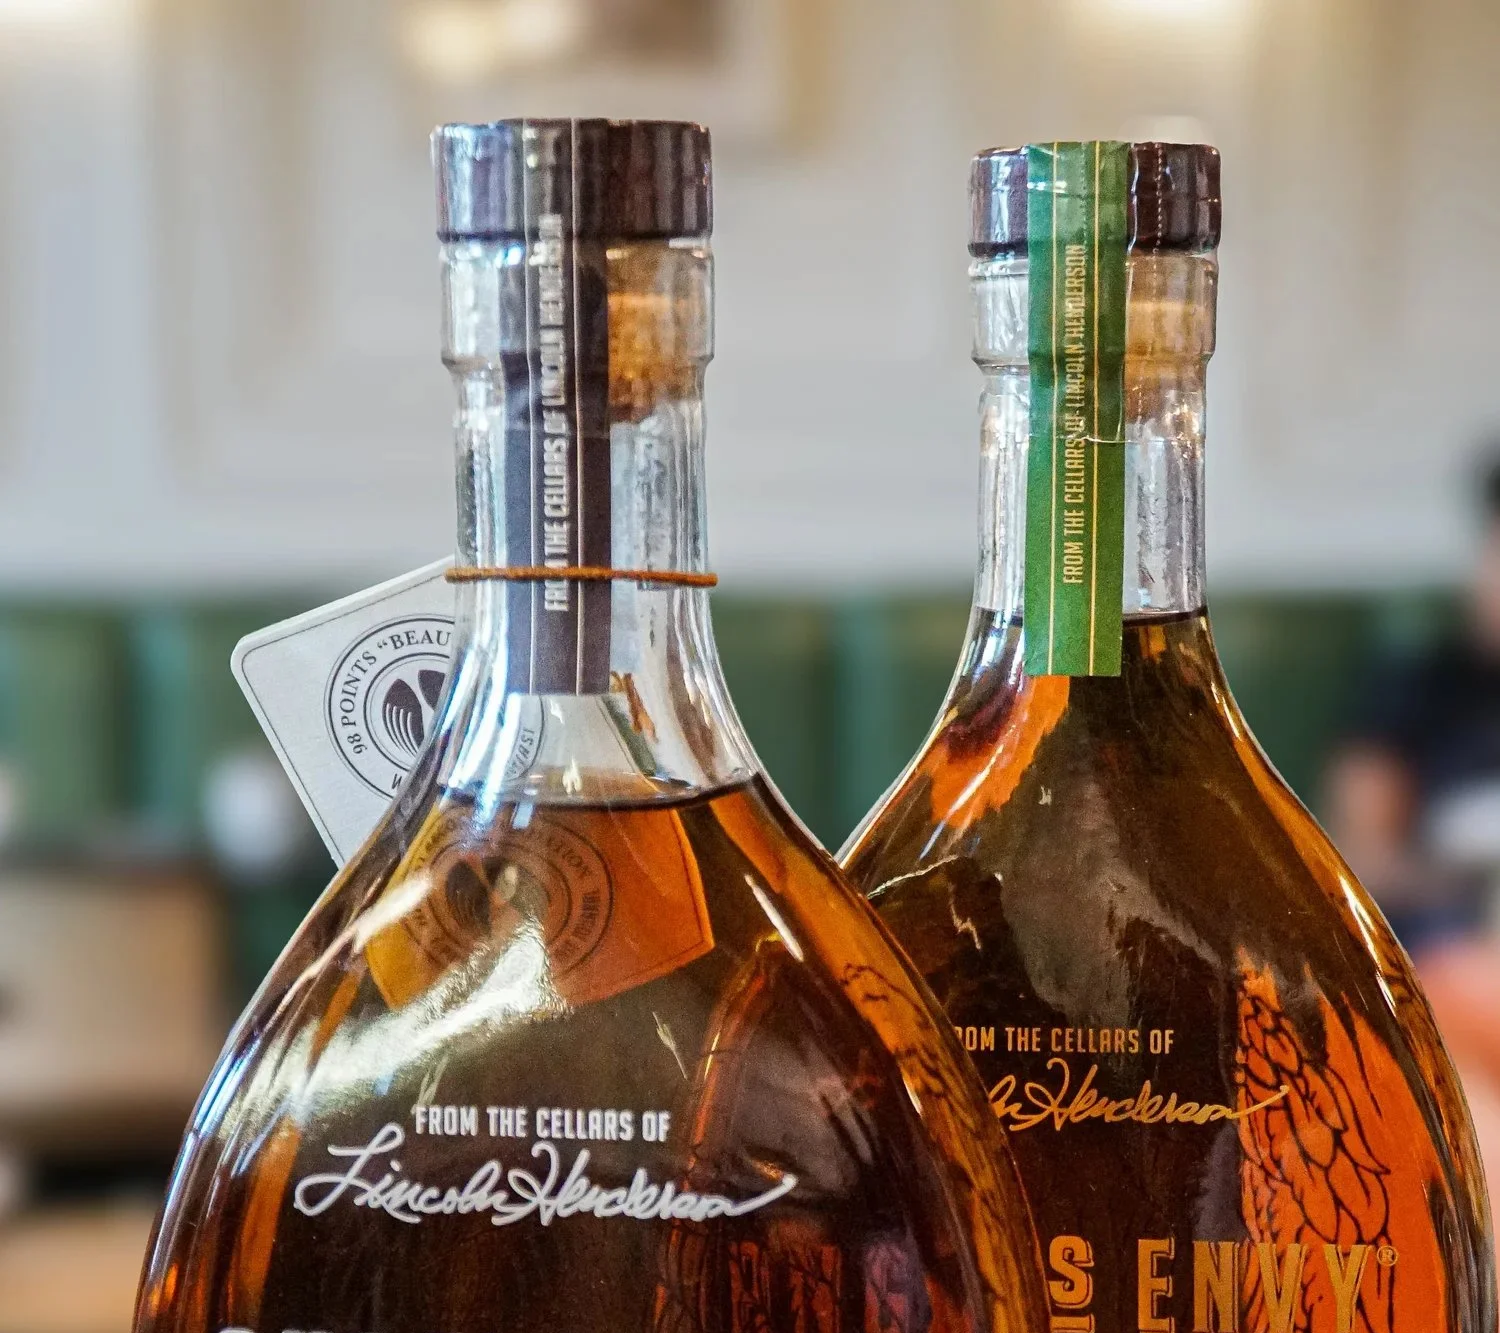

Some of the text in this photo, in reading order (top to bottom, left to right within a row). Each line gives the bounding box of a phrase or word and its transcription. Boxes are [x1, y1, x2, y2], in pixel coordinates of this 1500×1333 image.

[1065, 244, 1086, 340] HENDERSON
[1065, 345, 1085, 408] LINCOLN
[543, 437, 568, 518] CELLARS
[1064, 438, 1086, 504] CELLARS
[544, 521, 569, 555] THE
[1064, 510, 1085, 537] THE
[1063, 542, 1085, 584] FROM
[340, 649, 378, 728] POINTS
[346, 734, 368, 755] 98
[1004, 1026, 1041, 1052] THE
[1051, 1027, 1139, 1054] CELLARS
[1149, 1029, 1174, 1054] OF
[415, 1105, 671, 1143] FROM THE CELLARS OF
[294, 1122, 798, 1227] Lincoln Henderson
